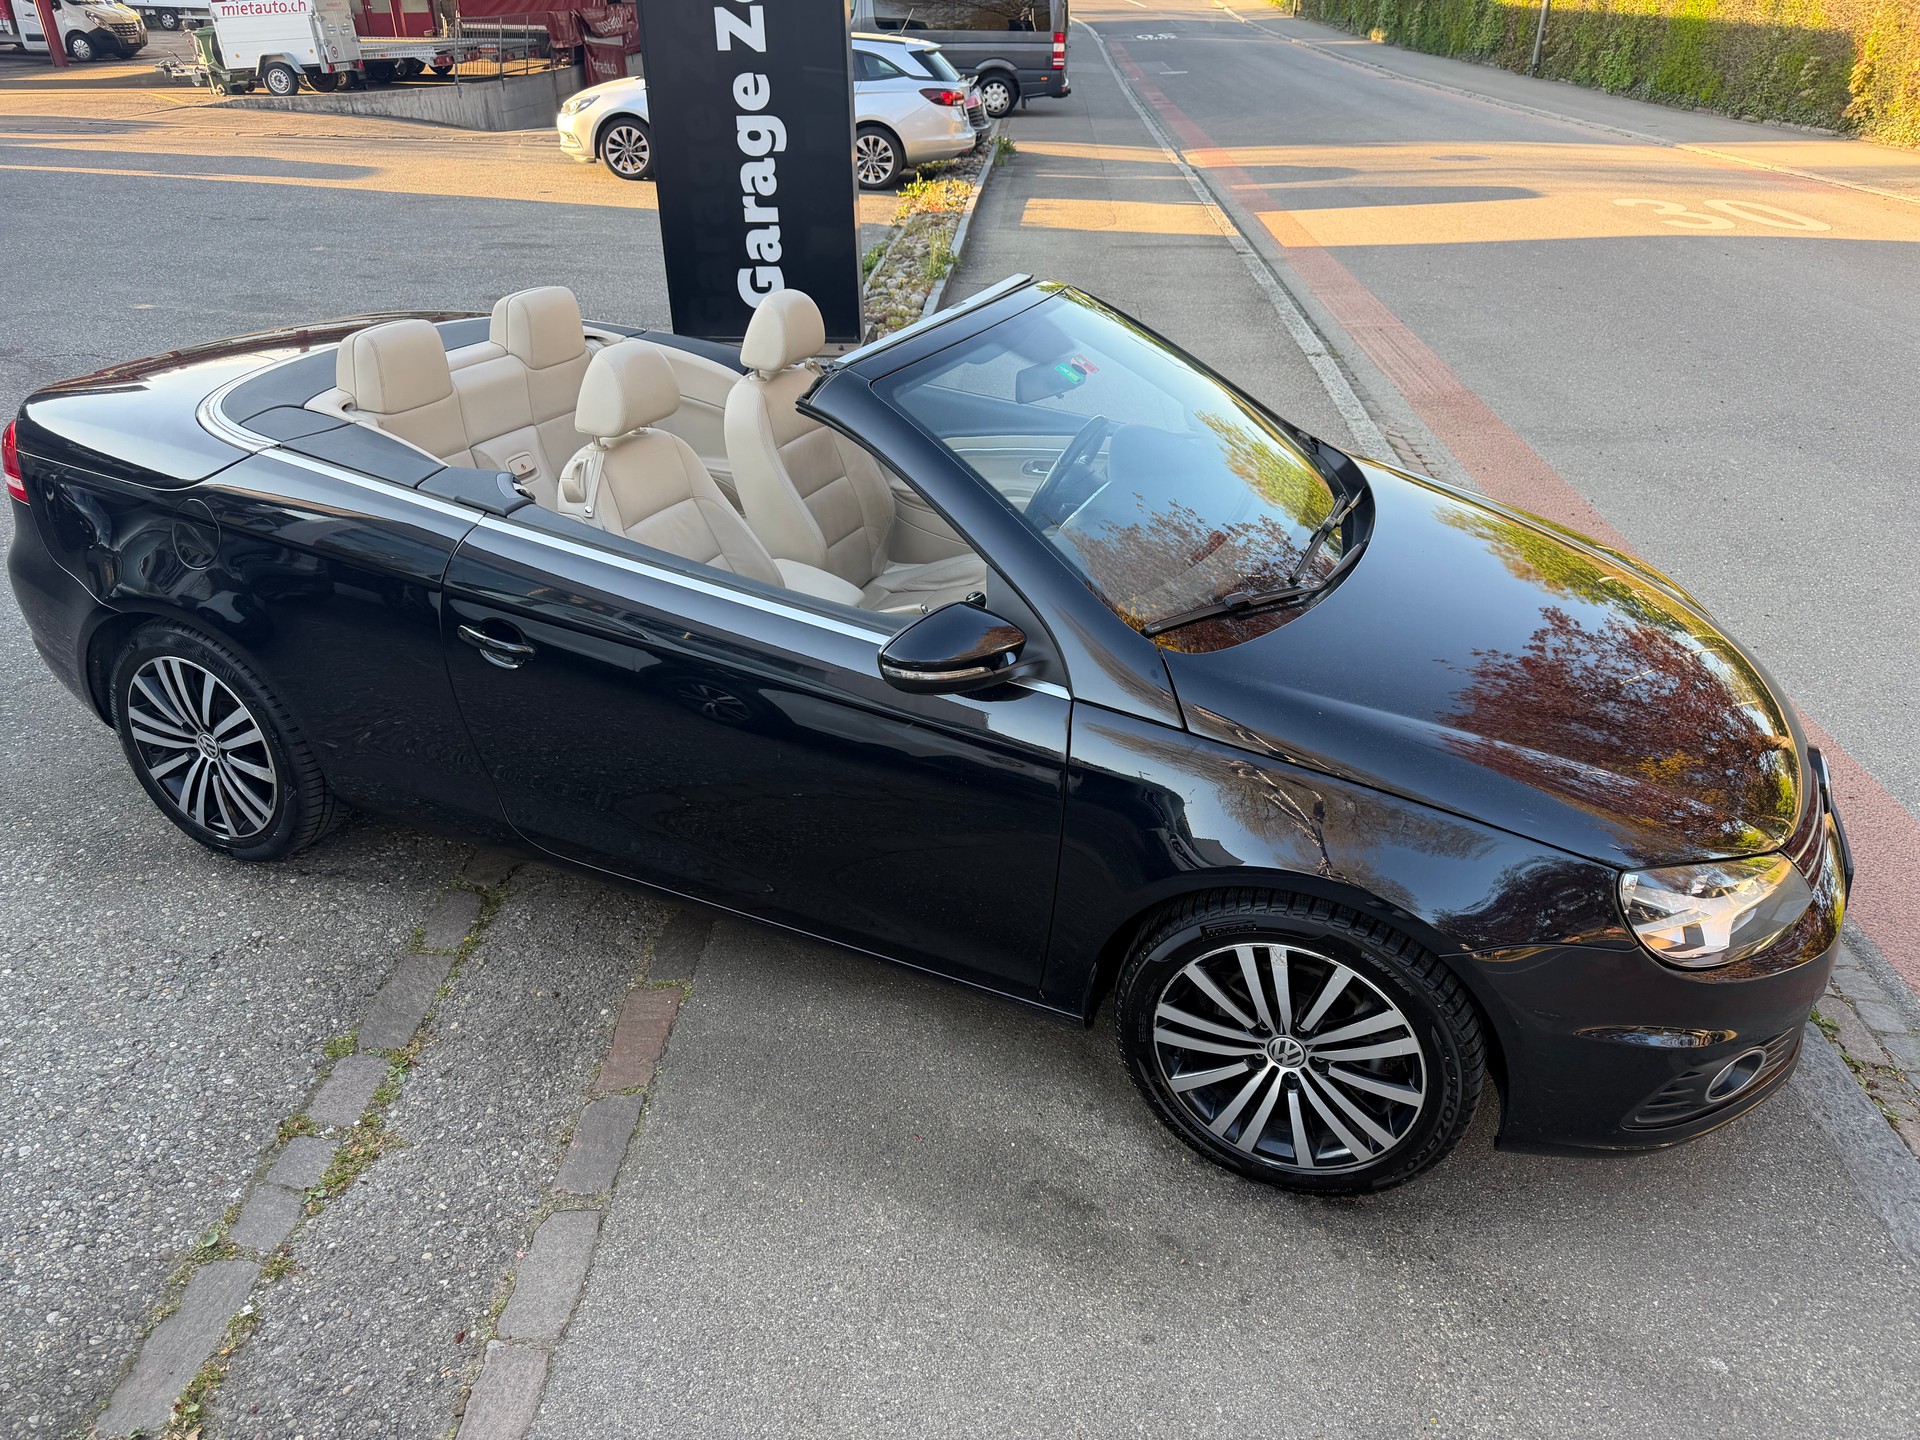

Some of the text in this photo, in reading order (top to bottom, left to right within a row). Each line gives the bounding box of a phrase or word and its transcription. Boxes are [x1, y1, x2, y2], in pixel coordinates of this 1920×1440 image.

[221, 0, 307, 16] mietauto.ch
[736, 72, 788, 310] Garage
[1613, 198, 1832, 231] 30
[1360, 951, 1416, 997] WINTER
